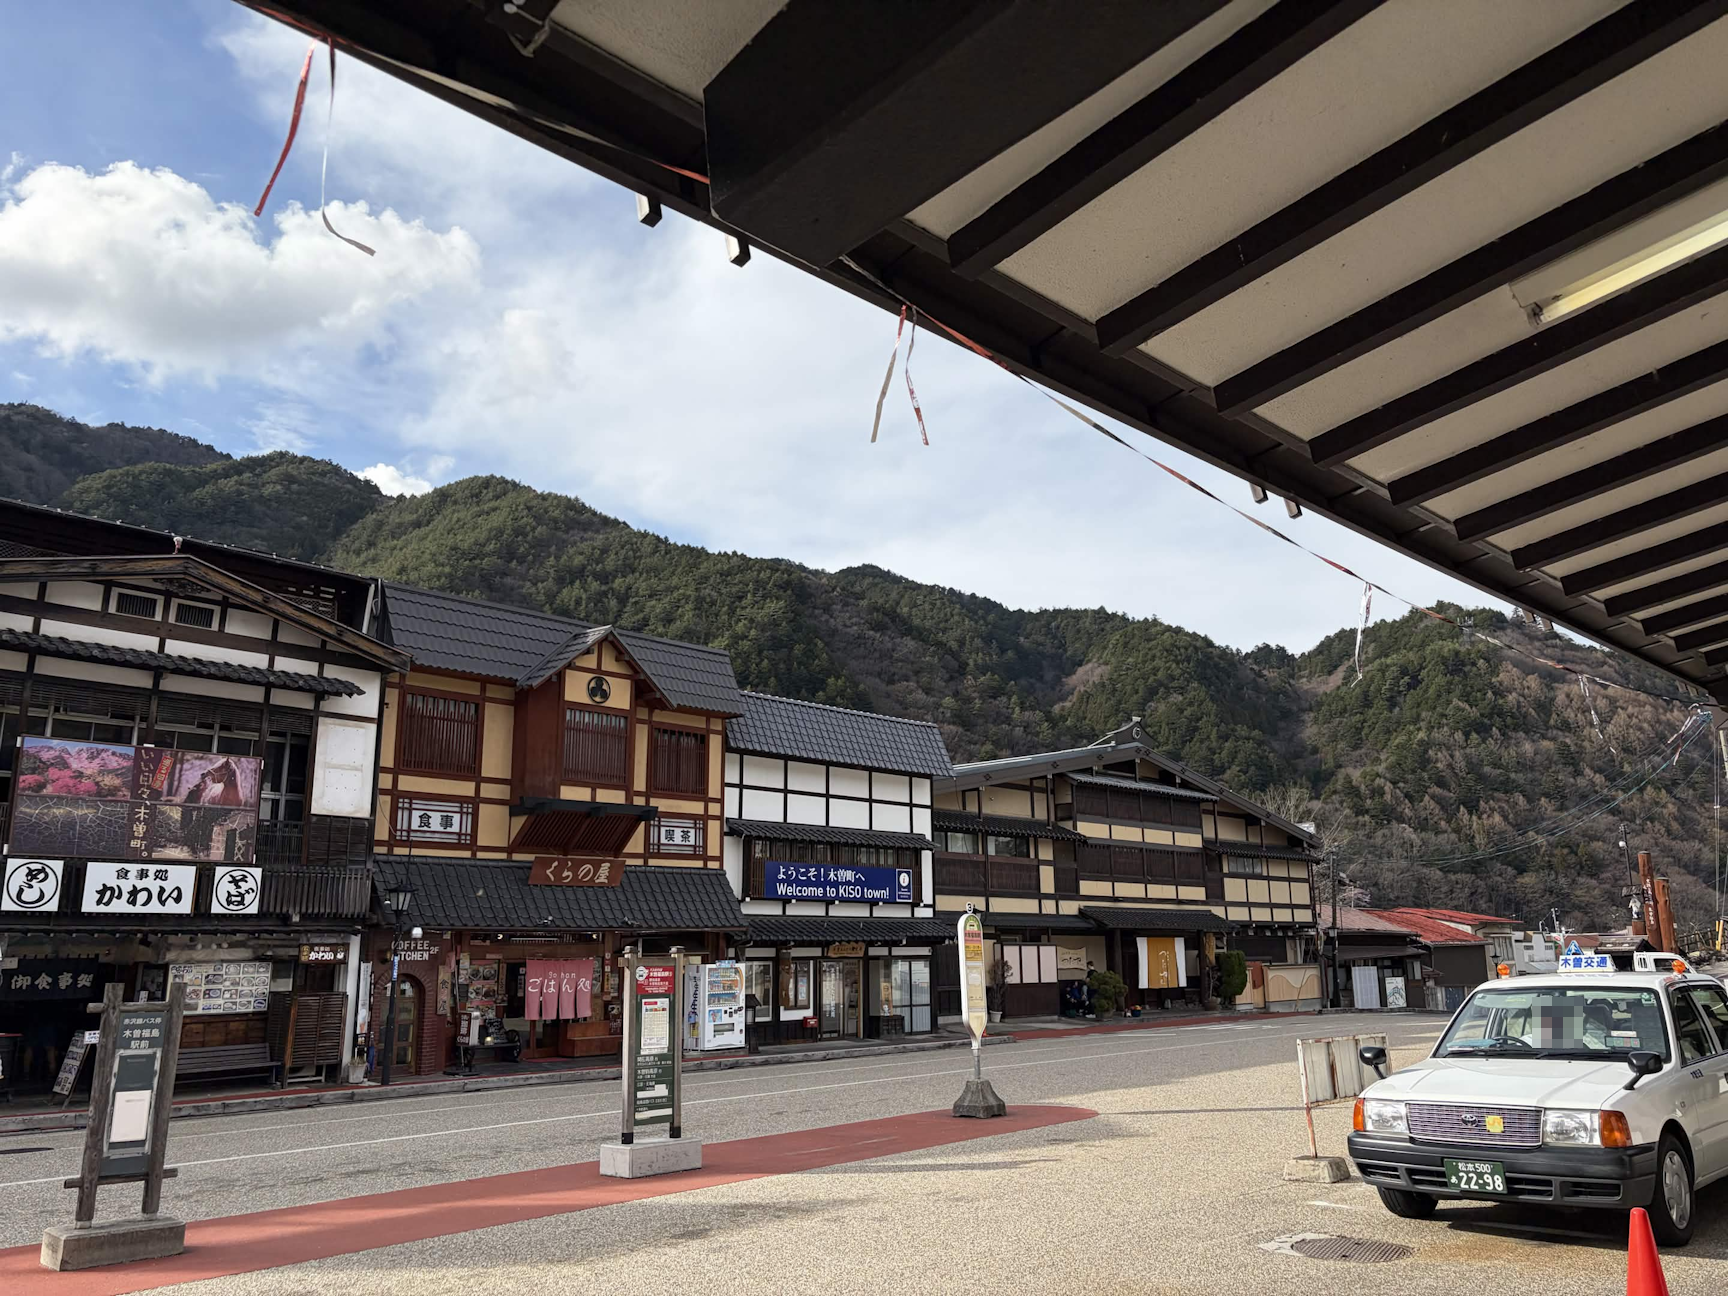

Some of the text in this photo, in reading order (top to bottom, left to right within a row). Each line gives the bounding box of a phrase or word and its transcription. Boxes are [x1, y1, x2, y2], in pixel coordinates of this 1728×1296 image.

[130, 749, 155, 857] いい日々、木曽町。
[418, 812, 455, 830] 食事
[664, 828, 691, 843] 喫茶
[115, 867, 169, 881] 食事処
[546, 861, 610, 883] くらの屋
[16, 866, 49, 904] めし
[225, 874, 255, 907] そば
[776, 882, 825, 897] Welcome
[826, 885, 836, 897] to
[839, 885, 861, 898] KISO
[864, 887, 889, 899] town!
[95, 884, 182, 907] かわい
[967, 903, 972, 911] 3
[308, 951, 334, 960] かわい
[391, 951, 429, 961] ITCHEN
[430, 946, 439, 955] 2F
[1561, 956, 1608, 968] 木曽交通
[11, 972, 94, 990] 御食事処
[528, 977, 591, 993] ごはん処
[122, 1028, 160, 1038] 木曽福島
[130, 1040, 150, 1049] 駅前
[1450, 1172, 1504, 1191] あ 22-98
